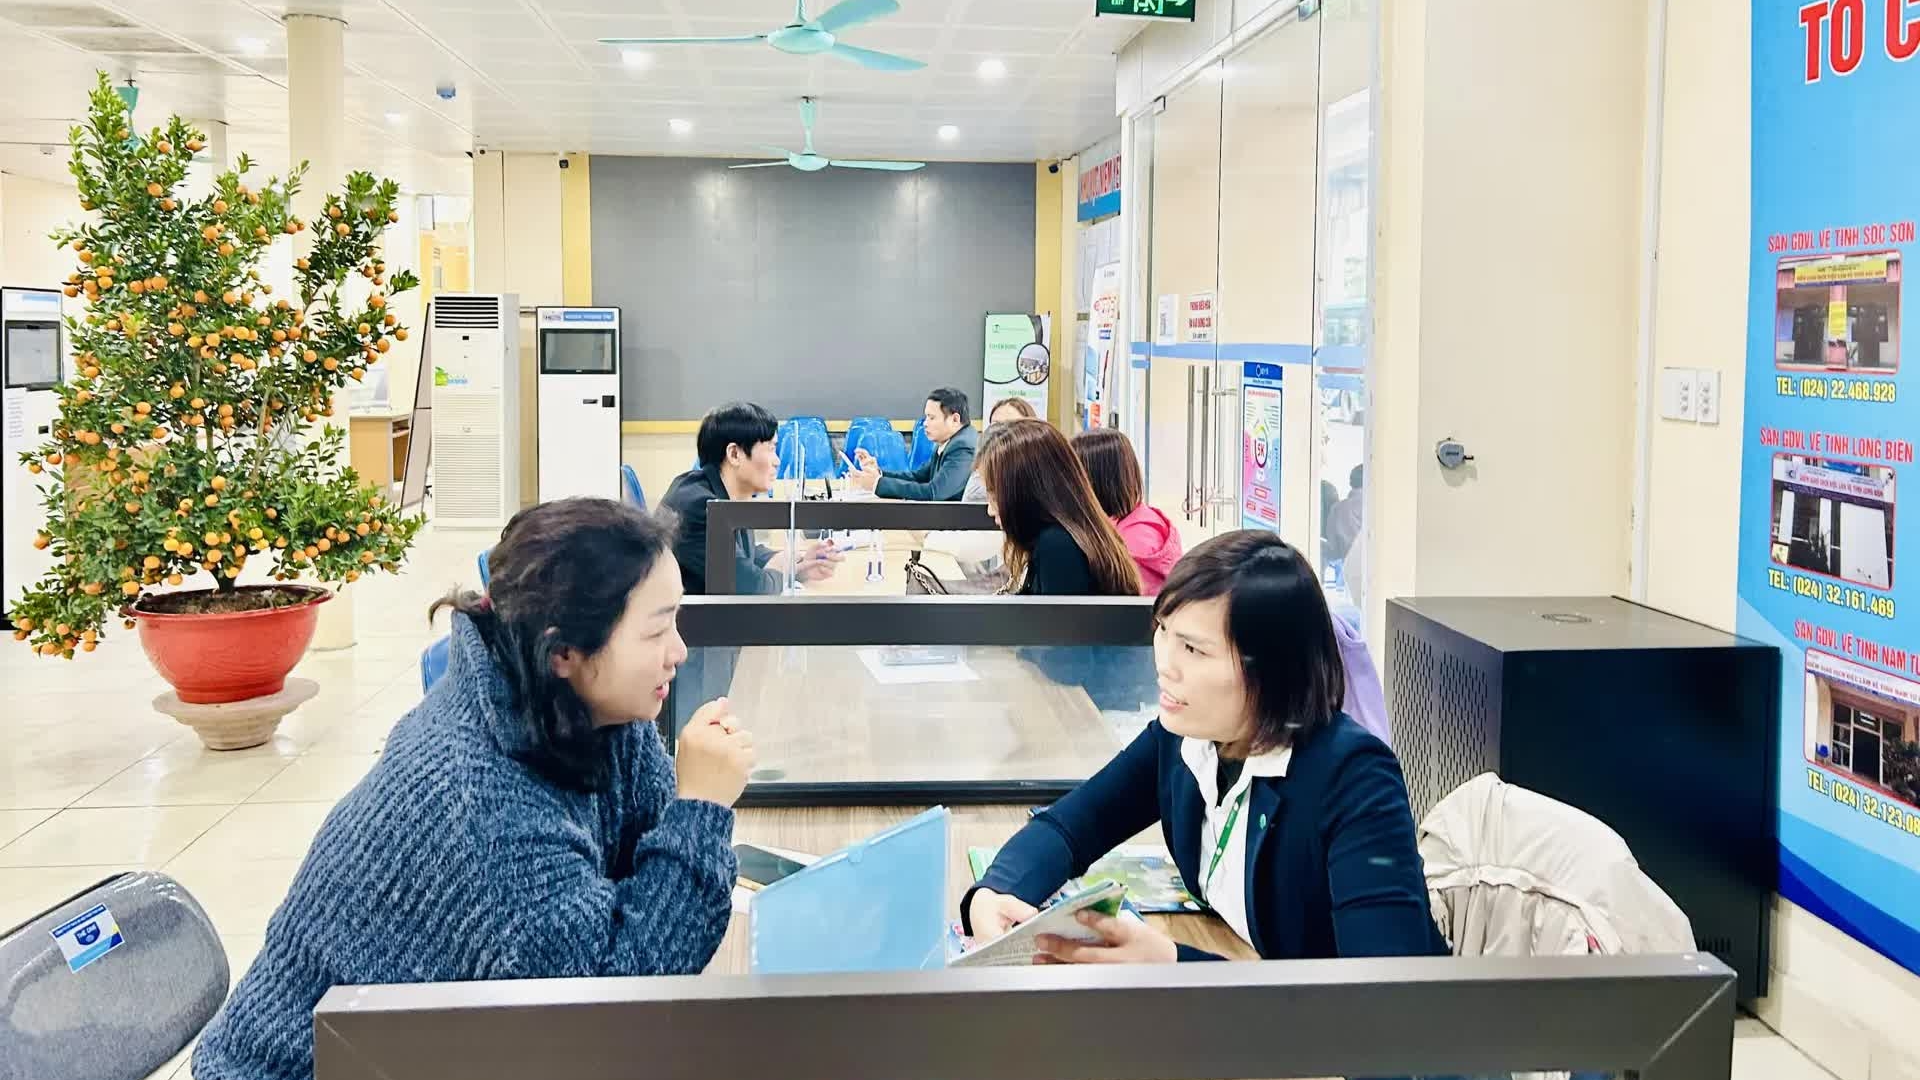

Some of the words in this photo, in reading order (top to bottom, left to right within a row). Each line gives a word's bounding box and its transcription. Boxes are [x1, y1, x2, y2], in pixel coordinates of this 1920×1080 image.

[1835, 228, 1859, 247] TINH
[1776, 376, 1797, 396] TEL:
[1800, 377, 1828, 399] (024)
[1831, 379, 1896, 403] 22.468.928
[1782, 430, 1806, 450] GDVL
[1825, 434, 1849, 455] TINH
[1852, 438, 1882, 459] LONG
[1768, 569, 1790, 591] TEL:
[1793, 575, 1822, 601] (024)
[1825, 582, 1896, 619] 32.161.469
[1856, 637, 1879, 662] TINH
[1881, 646, 1906, 671] NAM
[1807, 768, 1830, 796] TEL:
[1831, 779, 1861, 811] (024)
